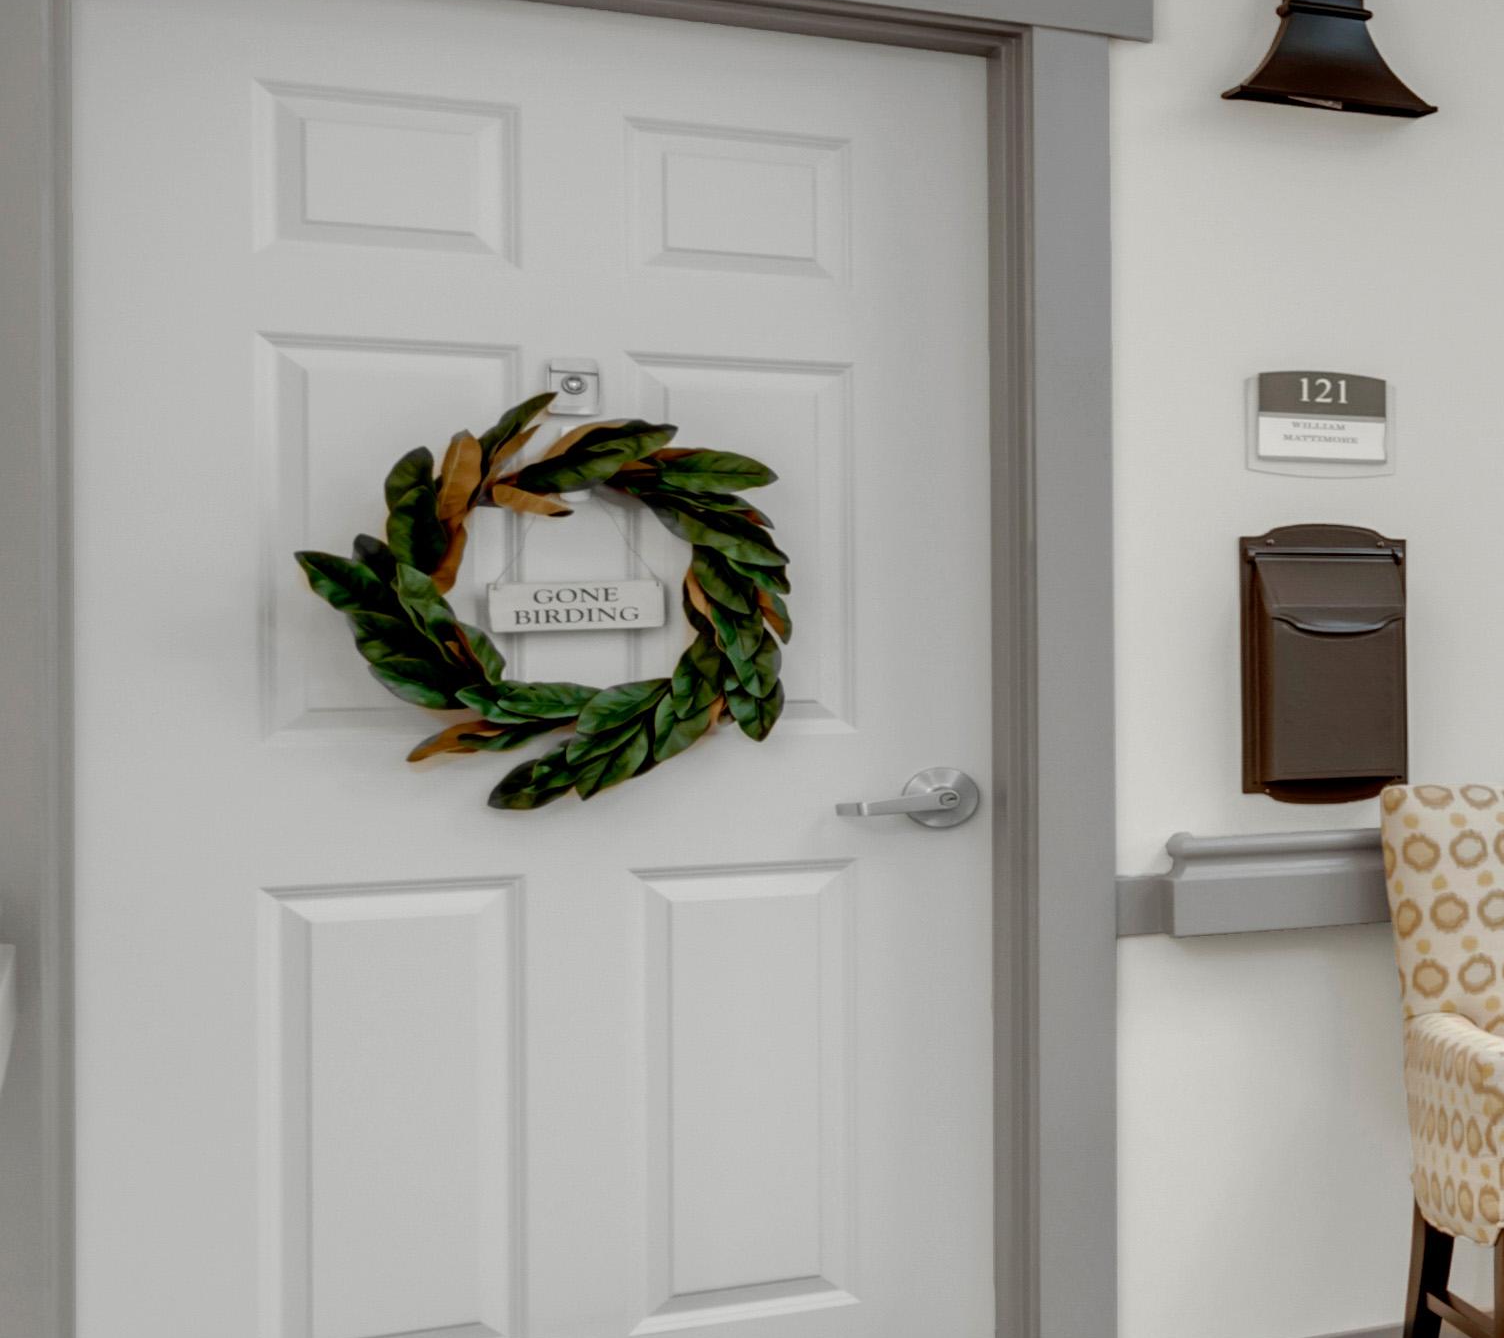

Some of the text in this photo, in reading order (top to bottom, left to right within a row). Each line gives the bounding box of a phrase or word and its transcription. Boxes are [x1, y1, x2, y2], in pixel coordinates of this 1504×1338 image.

[1299, 377, 1349, 404] 121
[1291, 420, 1346, 431] WILLIAM
[532, 586, 620, 604] GONE
[513, 606, 640, 626] BIRDING
